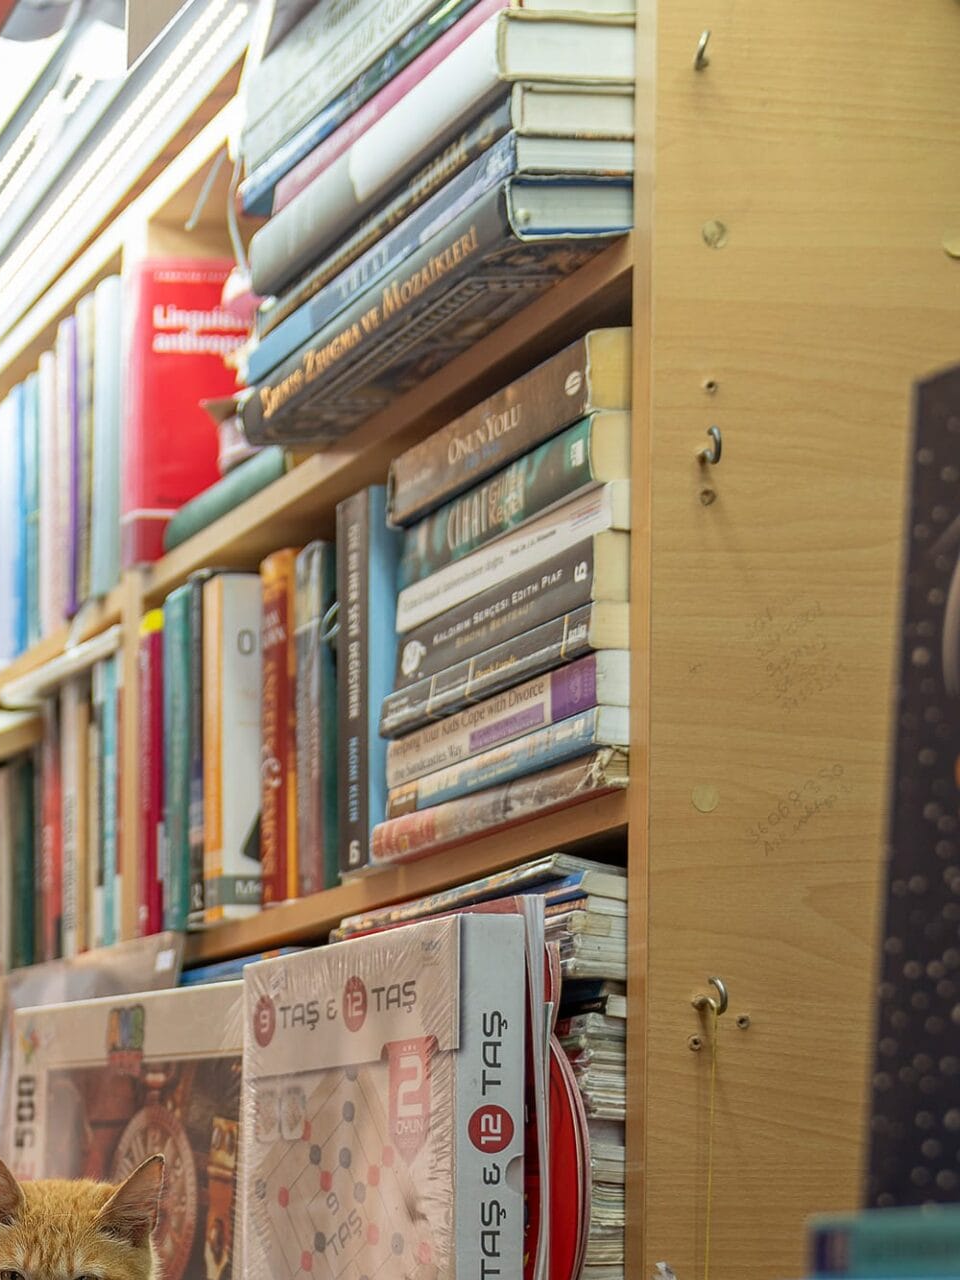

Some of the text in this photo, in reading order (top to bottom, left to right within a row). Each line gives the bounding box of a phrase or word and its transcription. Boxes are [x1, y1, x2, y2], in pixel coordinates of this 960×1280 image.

[259, 1008, 271, 1034] 9
[279, 1001, 320, 1031] TAŞ
[346, 991, 364, 1018] 12
[370, 980, 417, 1013] TAŞ
[482, 1010, 508, 1096] TAŞ
[397, 1054, 423, 1118] 2
[395, 1118, 424, 1136] OYUN
[480, 1113, 502, 1145] 12
[326, 1191, 340, 1216] 9
[326, 1208, 363, 1257] TAŞ
